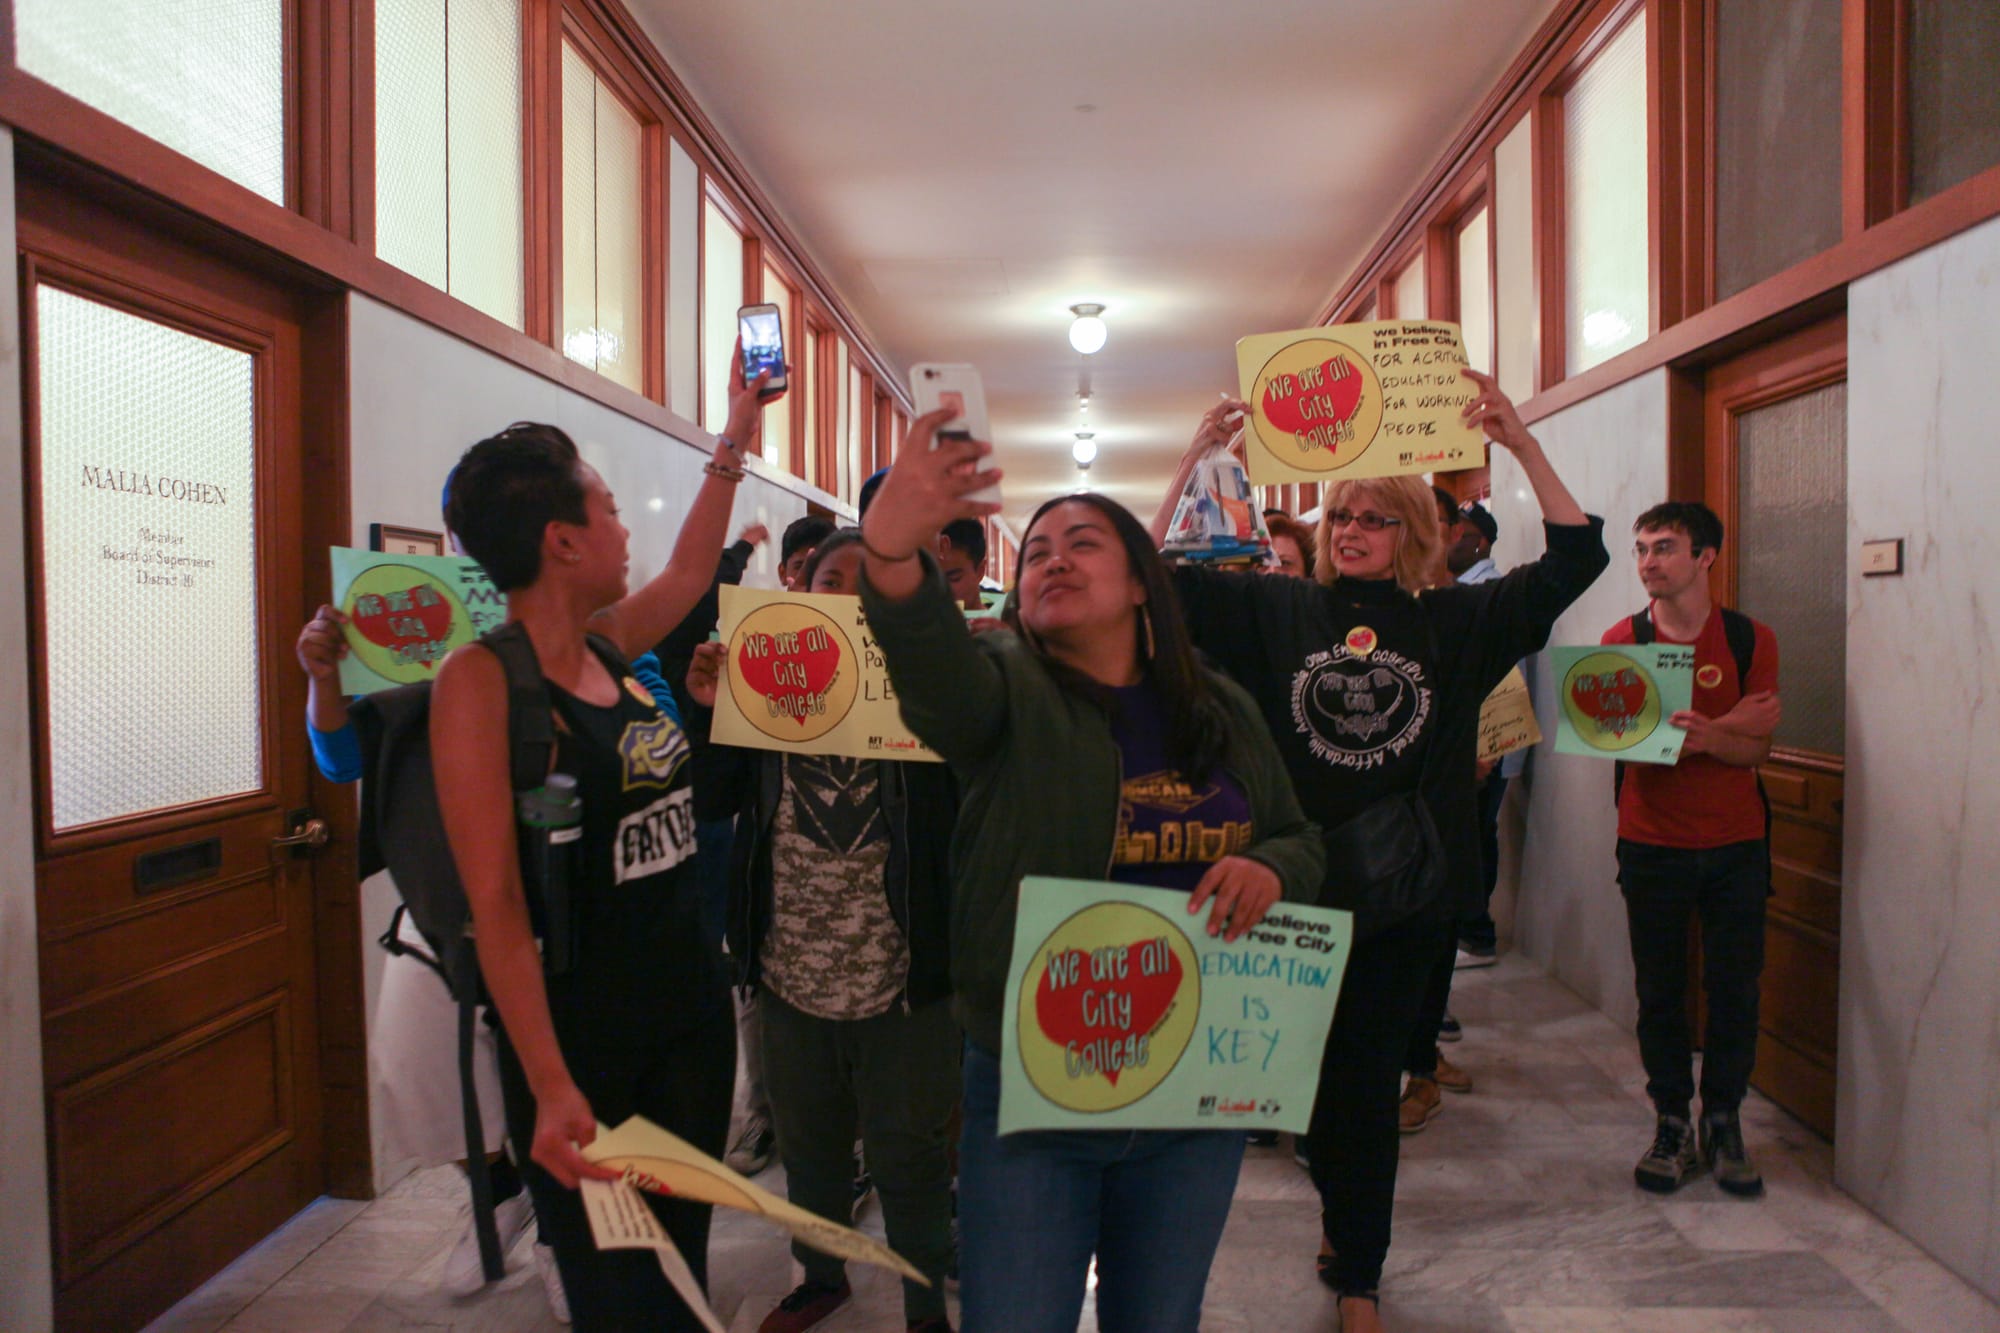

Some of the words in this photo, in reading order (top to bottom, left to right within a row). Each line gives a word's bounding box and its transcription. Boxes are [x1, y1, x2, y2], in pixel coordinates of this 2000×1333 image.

[1374, 329, 1397, 337] we
[1402, 326, 1451, 335] believe
[1374, 340, 1387, 349] in
[1392, 338, 1430, 347] Free
[1434, 337, 1457, 347] City
[1373, 353, 1403, 368] FOR
[1265, 373, 1293, 402] We
[1298, 365, 1324, 392] are
[1329, 354, 1351, 382] all
[1382, 375, 1456, 389] EDUCATION
[1298, 394, 1334, 420] City
[1295, 419, 1355, 453] College
[82, 465, 152, 496] MALIA
[158, 476, 227, 505] COHEN
[103, 545, 138, 561] Board
[742, 631, 769, 660] We
[774, 632, 800, 656] are
[806, 624, 830, 653] all
[772, 660, 808, 690] City
[766, 689, 827, 718] College
[1295, 934, 1335, 953] City
[1047, 947, 1081, 991] We
[1091, 945, 1129, 982] are
[1141, 936, 1170, 977] all
[1202, 951, 1332, 989] EDUCATION
[1081, 988, 1132, 1031] City
[1242, 995, 1269, 1021] IS
[1065, 1032, 1150, 1078] College
[1208, 1026, 1280, 1072] KEY
